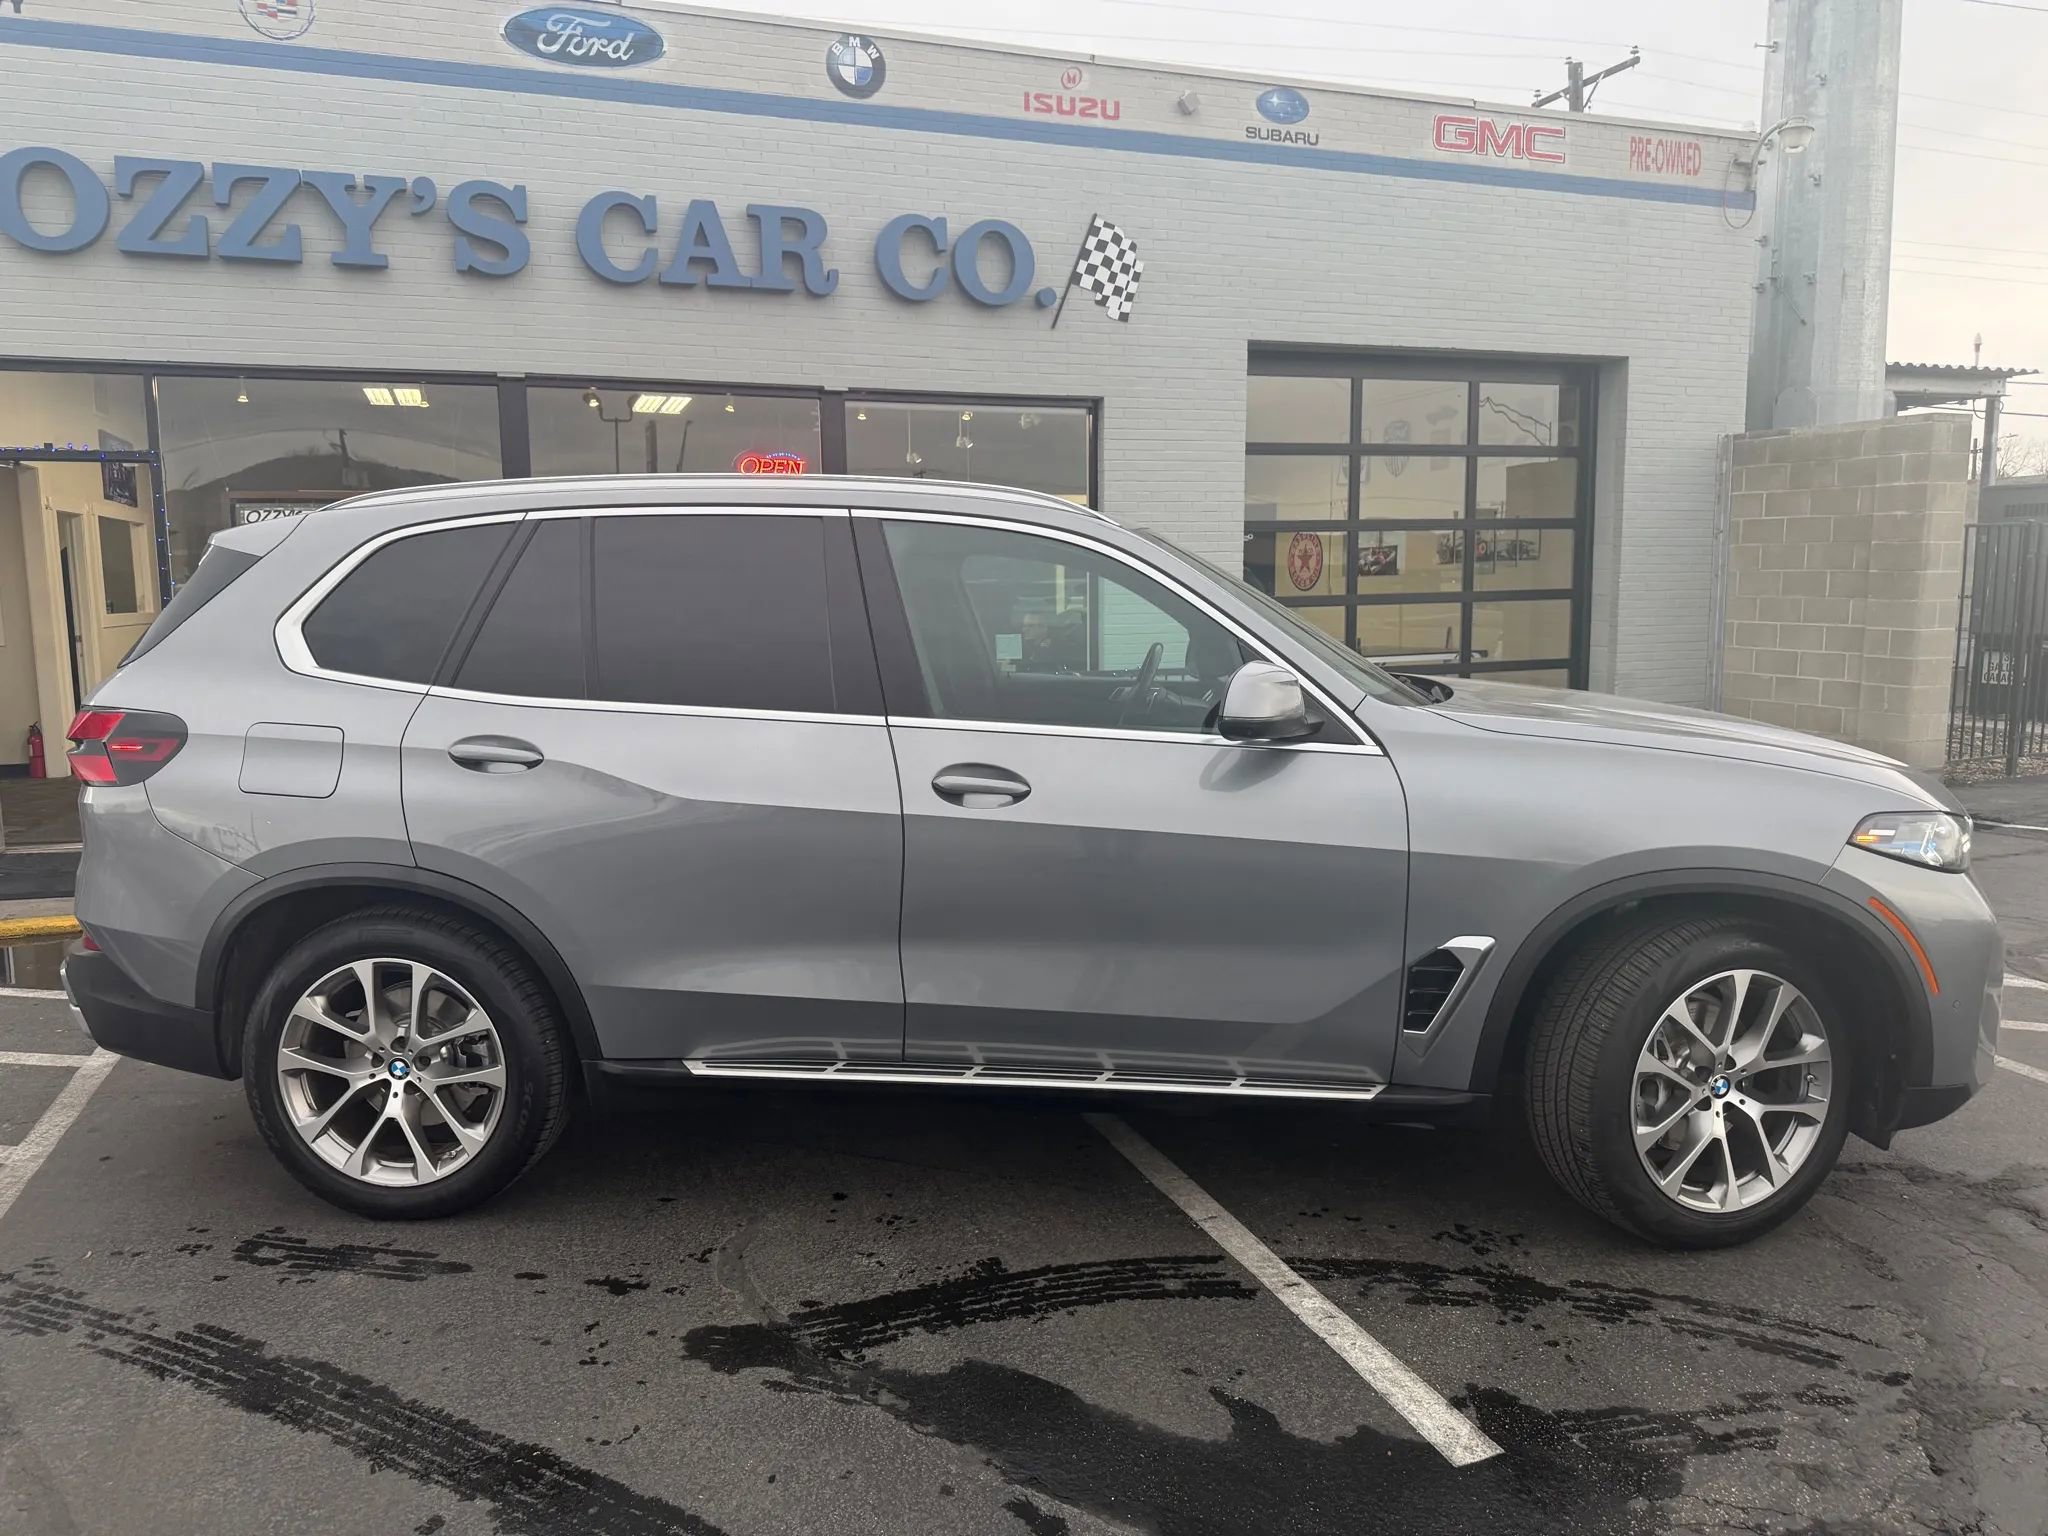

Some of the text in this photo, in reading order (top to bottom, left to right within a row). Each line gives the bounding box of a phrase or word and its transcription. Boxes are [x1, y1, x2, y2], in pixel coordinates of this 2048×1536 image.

[537, 13, 635, 61] Ford
[831, 35, 880, 60] BMW
[1023, 91, 1120, 121] ISUZU
[1245, 125, 1320, 147] SUBARU
[1432, 114, 1565, 164] GMC
[1628, 136, 1703, 177] PRE-OWNED
[575, 190, 839, 297] CAR
[875, 213, 1058, 309] CO.
[740, 456, 807, 475] OPEN
